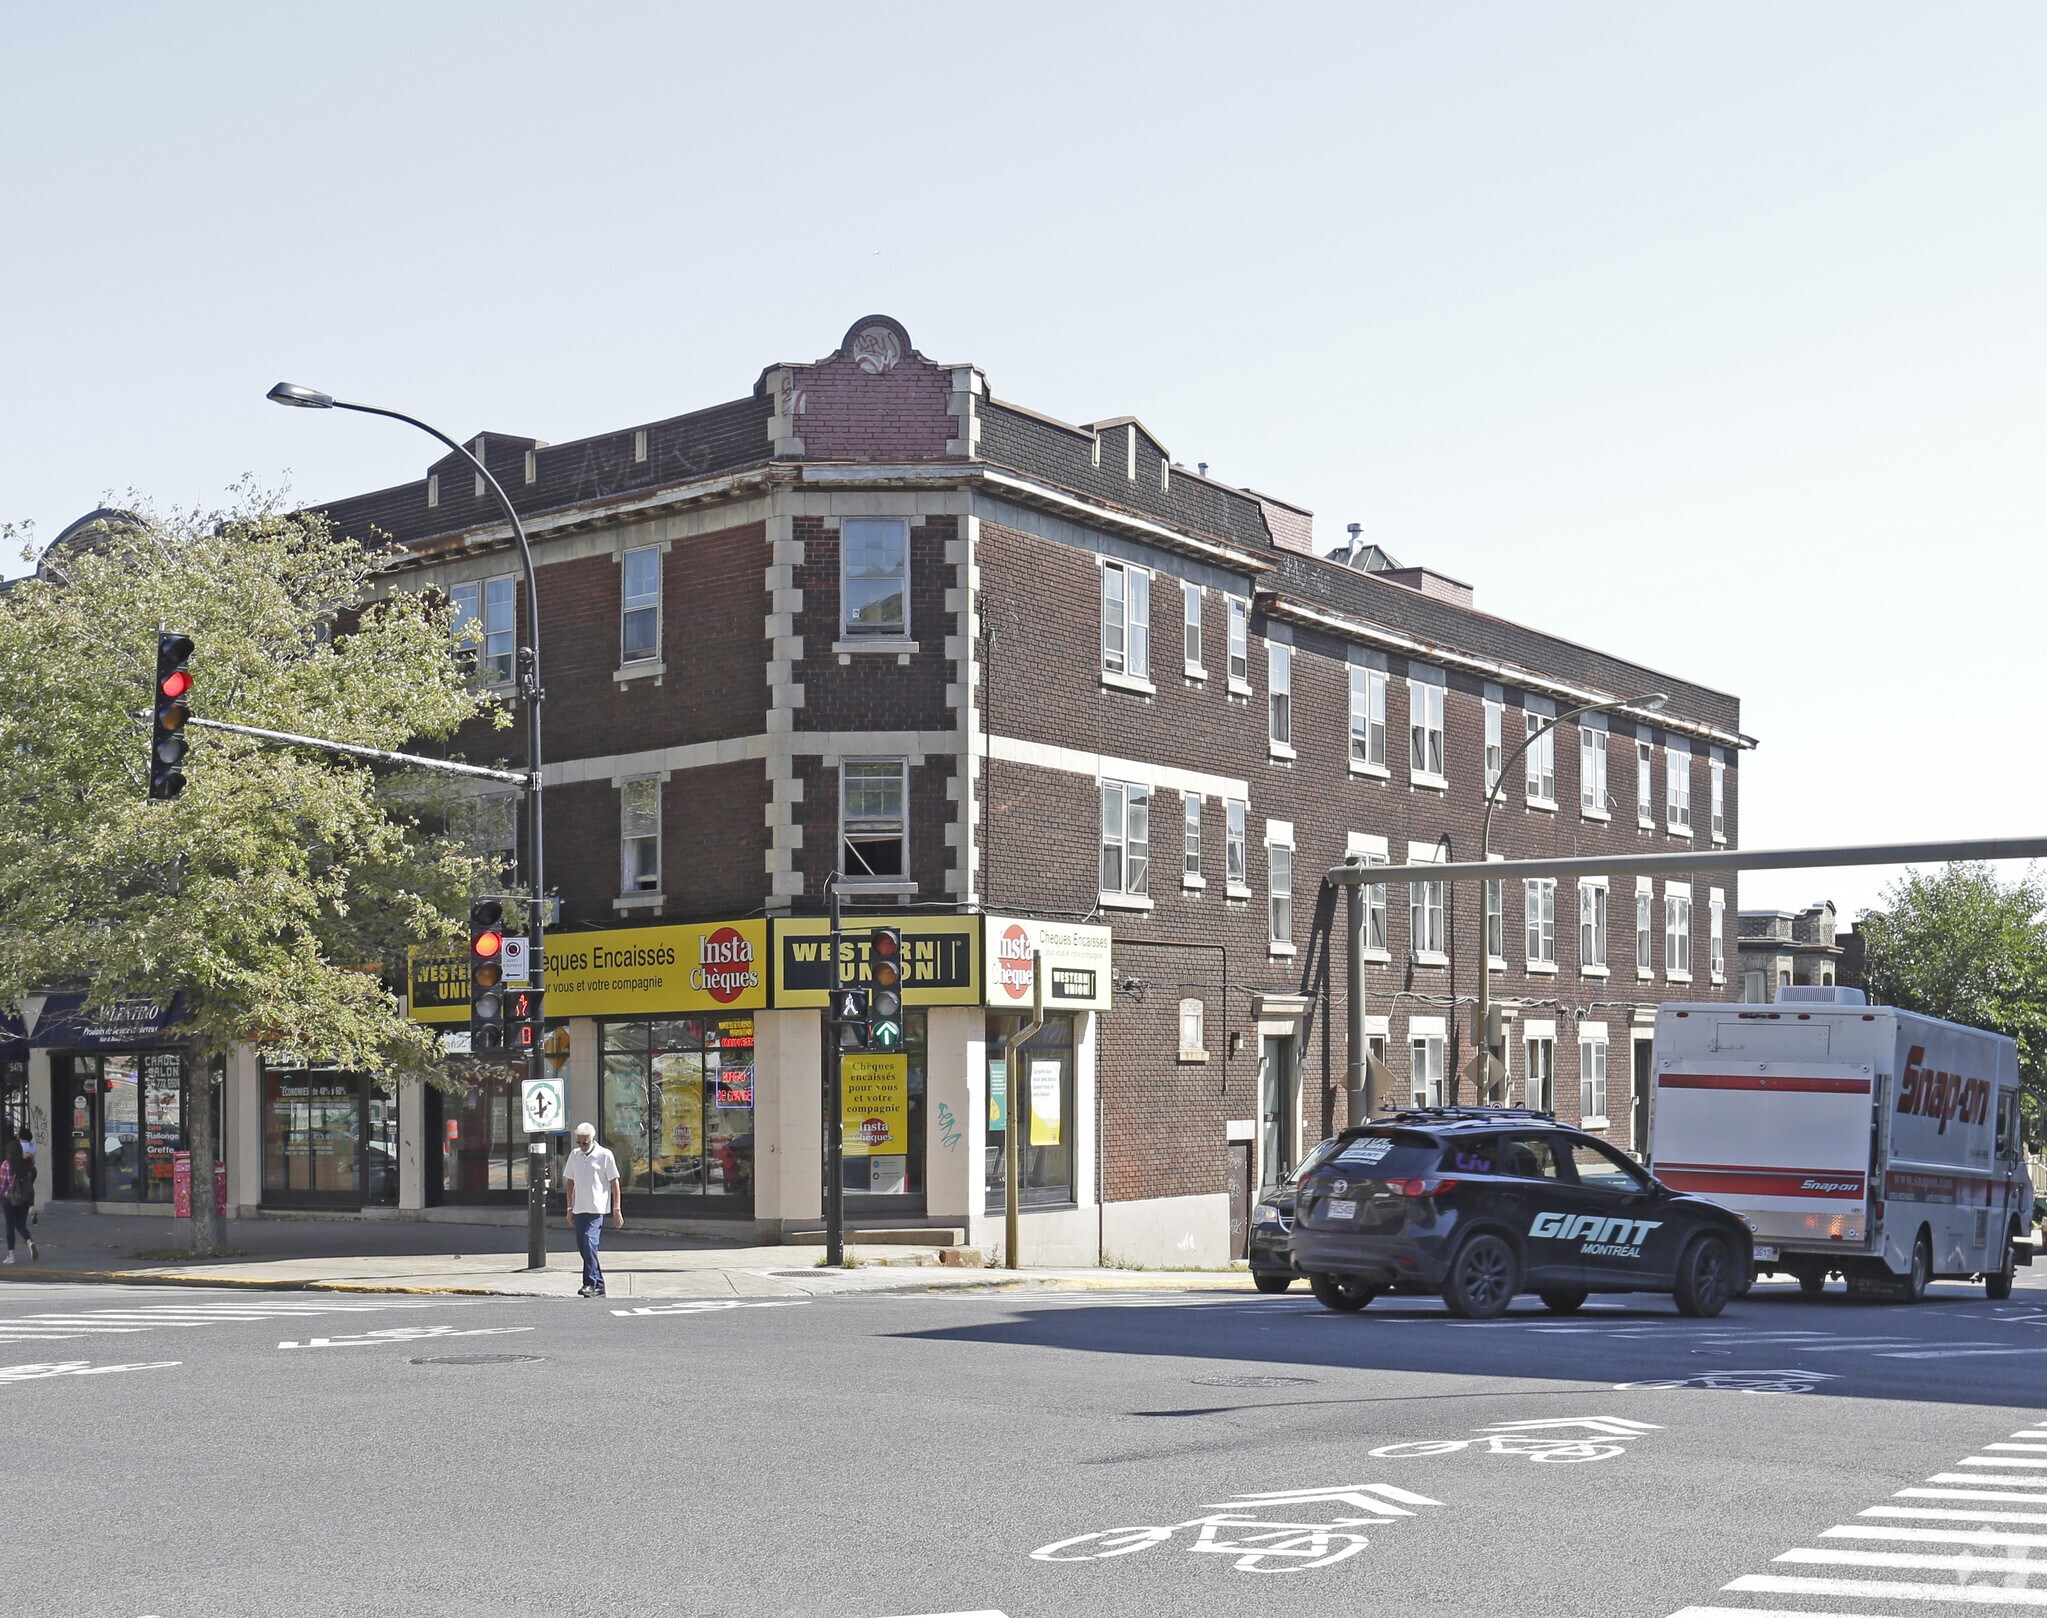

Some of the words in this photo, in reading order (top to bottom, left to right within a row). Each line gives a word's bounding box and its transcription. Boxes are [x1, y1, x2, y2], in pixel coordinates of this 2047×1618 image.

[699, 935, 753, 964] Insta
[792, 941, 934, 962] WESTRN
[543, 951, 587, 976] èques
[593, 943, 675, 969] Encaissés
[418, 964, 471, 982] WESTE
[840, 961, 934, 982] UNON
[993, 962, 1033, 991] Chèque
[1053, 971, 1091, 984] WESTERN
[553, 979, 574, 993] vous
[577, 977, 585, 992] et
[587, 976, 609, 991] votre
[612, 974, 663, 992] compagnie
[690, 968, 758, 993] Chèques
[439, 982, 471, 999] UNI
[1064, 983, 1091, 996] UNION
[852, 1062, 895, 1072] Chèques
[850, 1072, 896, 1081] encaissés
[848, 1084, 873, 1093] pour
[876, 1084, 898, 1092] vous
[1897, 1045, 1991, 1135] Snap-on
[846, 1106, 900, 1114] compagnie
[859, 1121, 889, 1132] Insta
[147, 1132, 179, 1141] Rallonge
[852, 1132, 894, 1143] Chèques
[147, 1146, 175, 1154] Greffe
[1455, 1153, 1491, 1171] Liv
[1801, 1180, 1859, 1192] Snap-on
[1528, 1212, 1663, 1245] GIANT
[1580, 1243, 1641, 1258] MONTRÉAL
